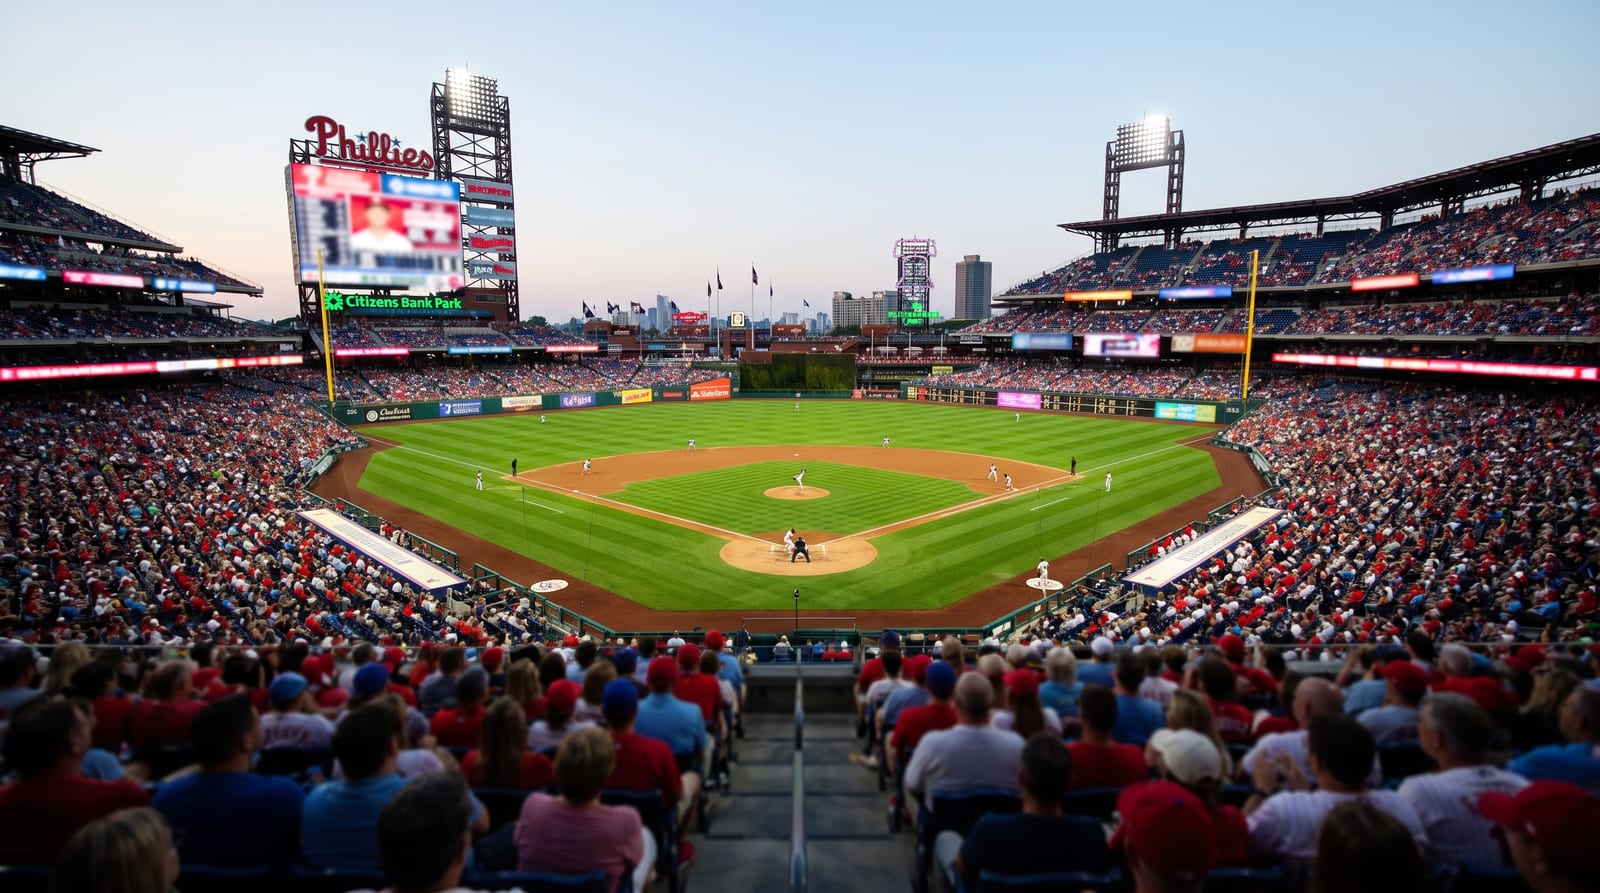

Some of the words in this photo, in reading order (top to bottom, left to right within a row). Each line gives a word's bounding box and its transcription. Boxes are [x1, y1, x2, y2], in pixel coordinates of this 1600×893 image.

[305, 115, 435, 170] Phillies
[346, 295, 399, 308] Citizens
[401, 297, 433, 309] Bank
[435, 297, 462, 309] Park
